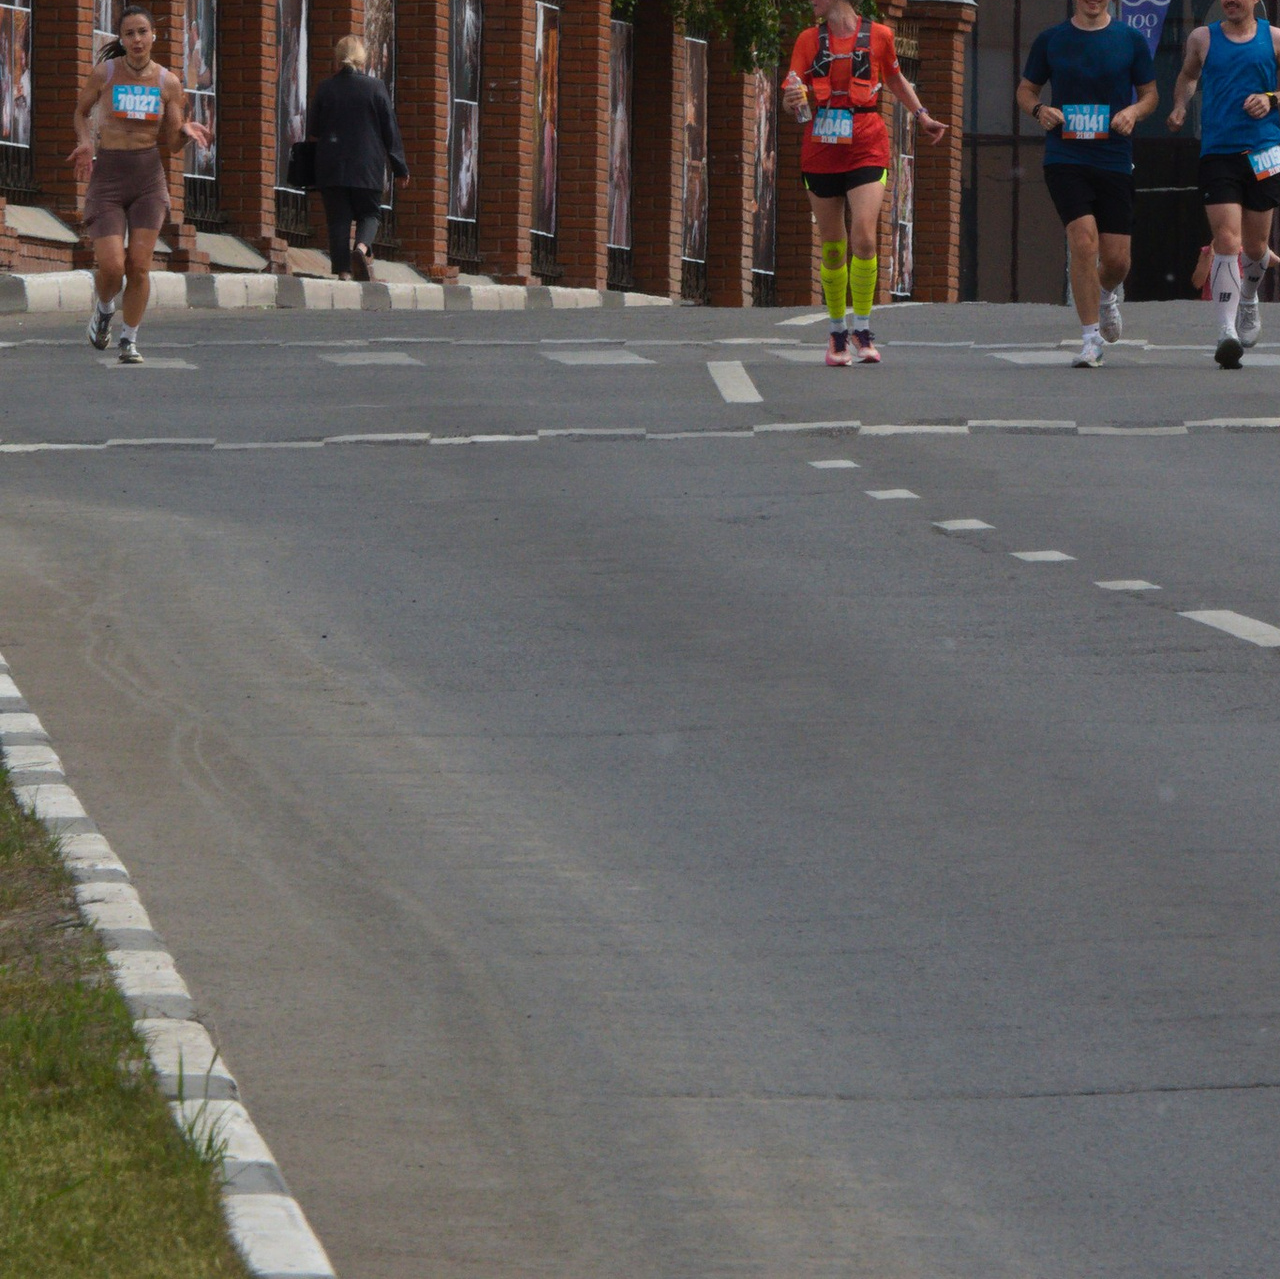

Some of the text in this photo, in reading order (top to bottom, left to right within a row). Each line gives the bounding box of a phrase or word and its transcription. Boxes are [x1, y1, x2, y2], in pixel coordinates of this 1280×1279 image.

[1126, 13, 1158, 29] 100
[118, 93, 156, 112] 70127
[1068, 114, 1104, 132] 70141
